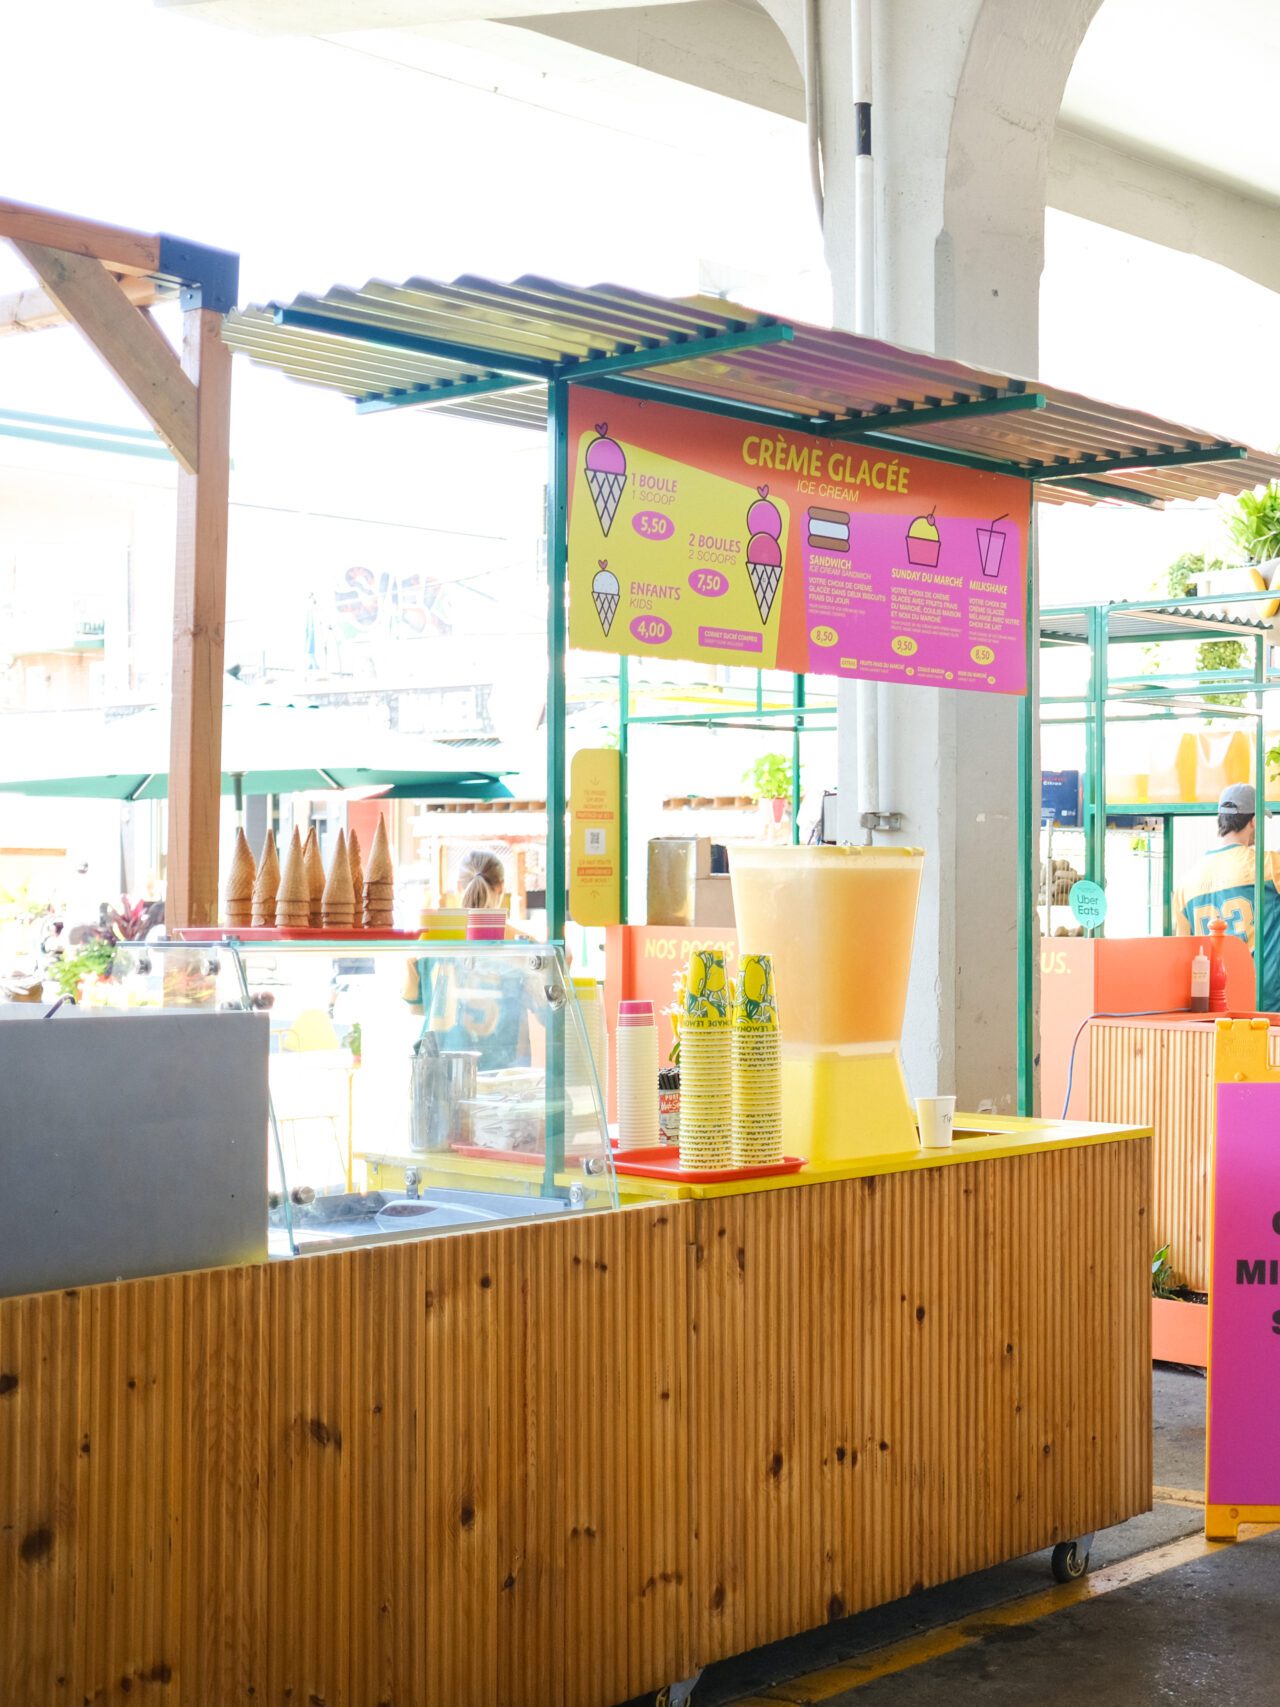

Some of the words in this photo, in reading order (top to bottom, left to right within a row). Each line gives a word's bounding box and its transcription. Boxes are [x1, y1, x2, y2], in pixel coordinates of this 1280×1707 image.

[742, 433, 823, 477] CRÈME
[828, 453, 910, 494] GLACÉE
[631, 473, 636, 486] 1
[639, 474, 678, 493] BOULE
[796, 479, 816, 495] ICE
[818, 483, 860, 503] CREAM
[631, 490, 636, 500] 1
[640, 490, 676, 505] SCOOP
[640, 516, 667, 534] 5,50
[689, 533, 696, 547] 2
[698, 534, 741, 554] BOULES
[688, 549, 695, 559] 2
[697, 550, 738, 565] SCOOPS
[810, 554, 852, 570] SANDWICH
[697, 574, 721, 592] 7,50
[891, 567, 921, 581] SUNDAY
[921, 572, 933, 583] DU
[933, 574, 963, 588] MARCHÉ
[630, 581, 681, 600] ENFANTS
[969, 580, 1008, 595] MILKSHAKE
[629, 598, 653, 610] KIDS
[638, 620, 665, 638] 4,00
[815, 630, 833, 643] 8,50
[896, 640, 912, 652] 9,50
[975, 650, 990, 661] 8,50
[1076, 894, 1098, 906] Uber
[1078, 905, 1100, 916] Eats
[644, 938, 677, 960] NOS
